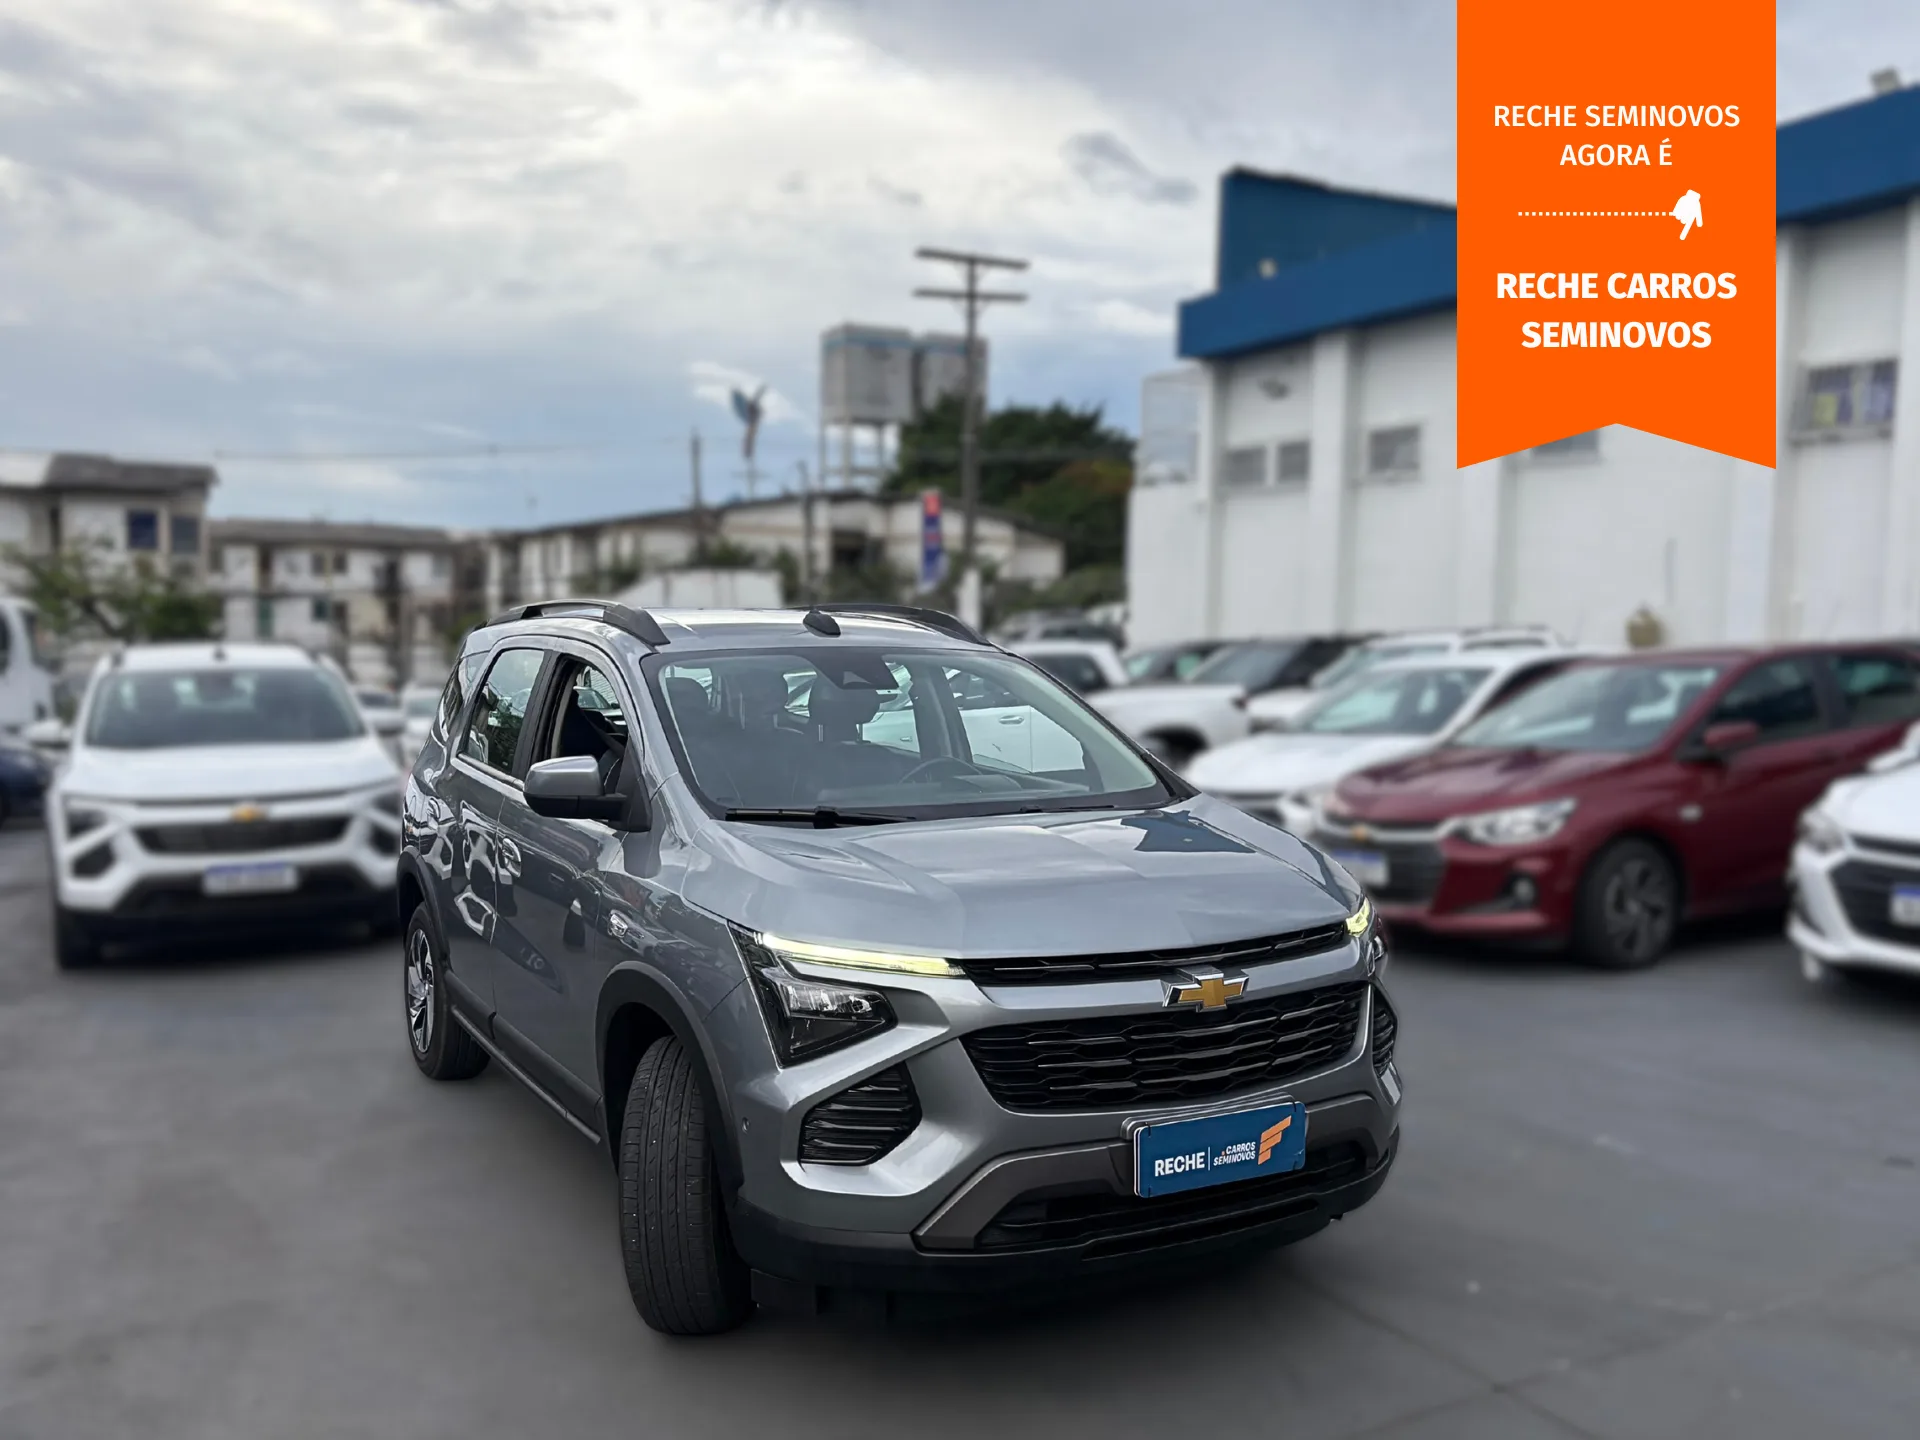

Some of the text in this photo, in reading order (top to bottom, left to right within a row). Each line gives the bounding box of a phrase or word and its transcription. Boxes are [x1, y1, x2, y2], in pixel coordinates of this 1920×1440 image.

[1225, 1141, 1256, 1154] CARROS
[1154, 1152, 1206, 1177] RECHE
[1213, 1151, 1256, 1166] SEMINOVOS
